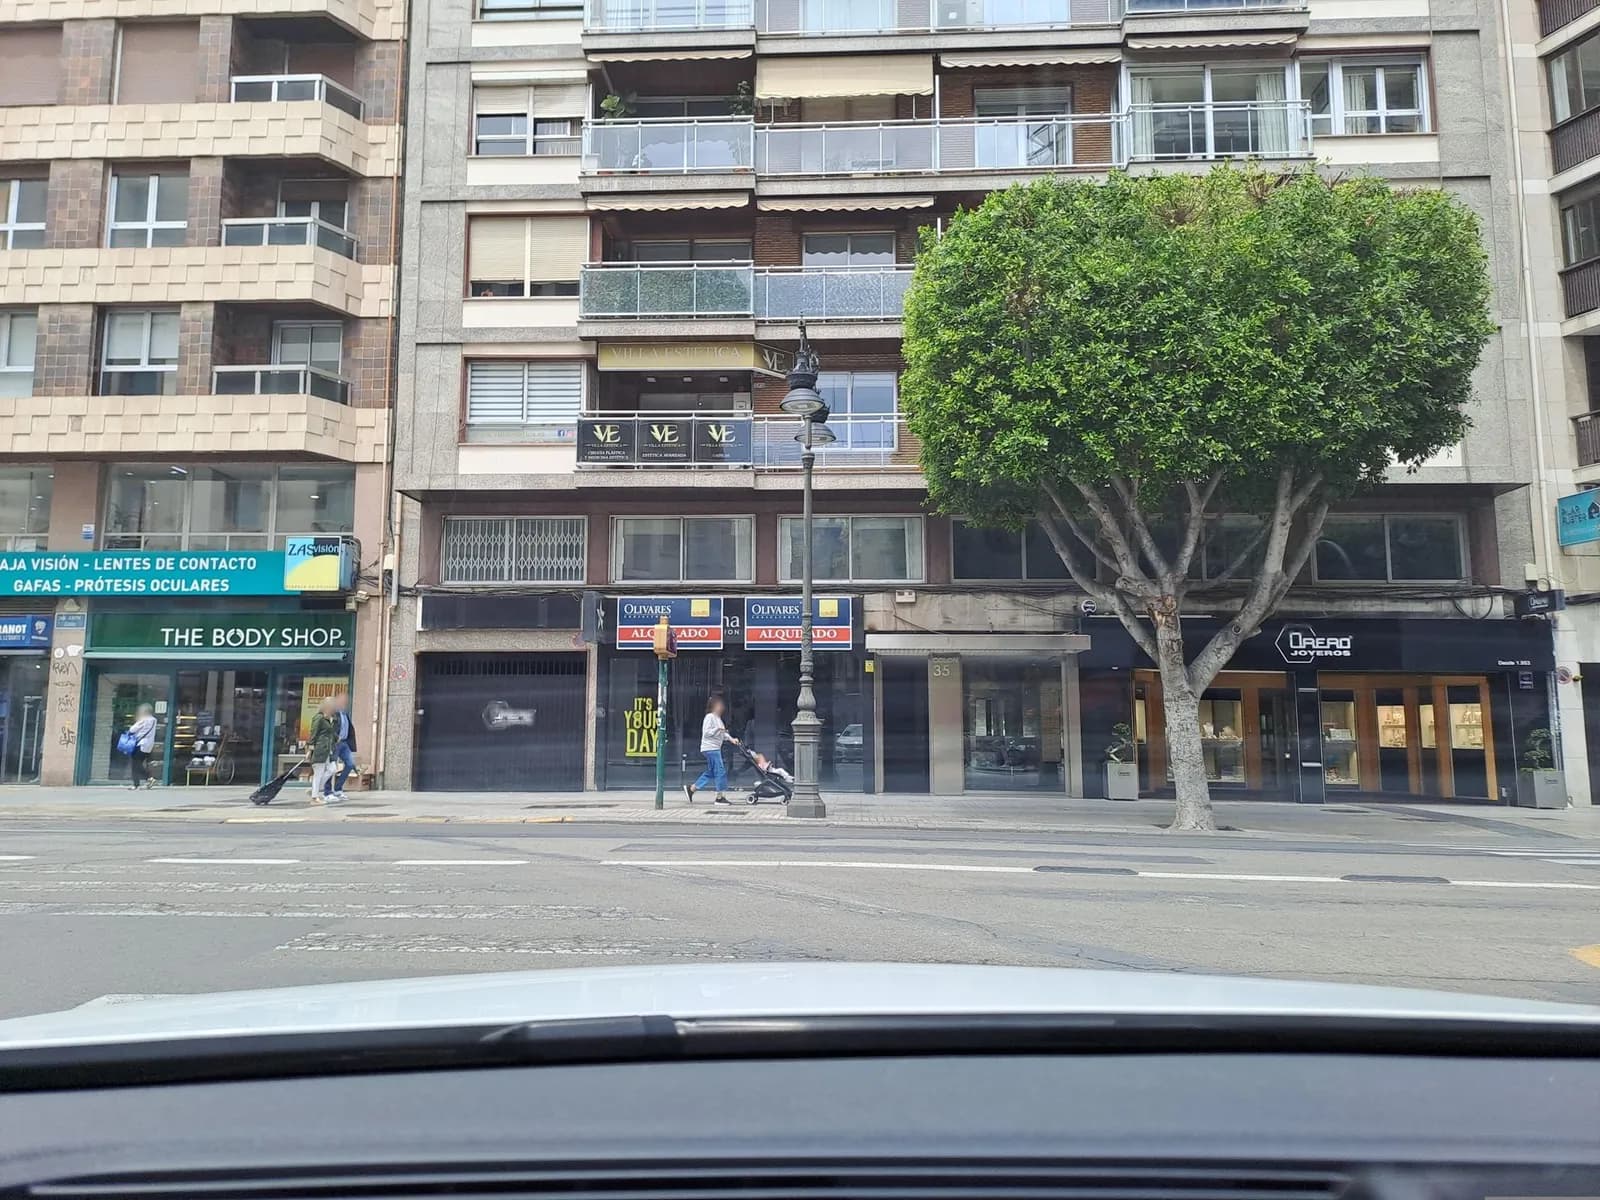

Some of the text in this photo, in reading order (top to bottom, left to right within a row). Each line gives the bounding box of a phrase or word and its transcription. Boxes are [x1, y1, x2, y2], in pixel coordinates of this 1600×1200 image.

[593, 424, 621, 443] VE
[650, 424, 679, 443] VE
[707, 424, 736, 443] VE
[31, 554, 79, 571] VISIÓN
[93, 557, 151, 571] LENTES
[155, 557, 175, 570] DE
[179, 557, 257, 570] CONTACTO
[13, 579, 61, 592] GAFAS
[74, 575, 146, 592] PRÓTESIS
[150, 579, 230, 592] OCULARES
[624, 603, 672, 615] OLIVARES
[751, 604, 800, 615] OLIVARES
[160, 628, 204, 647] THE
[212, 627, 276, 647] BODY
[631, 628, 709, 639] ALQADO
[759, 629, 837, 640] ALQUIADO
[933, 664, 951, 677] 35
[308, 682, 334, 698] GLOW
[634, 697, 653, 711] IT'S
[626, 729, 659, 753] DAY
